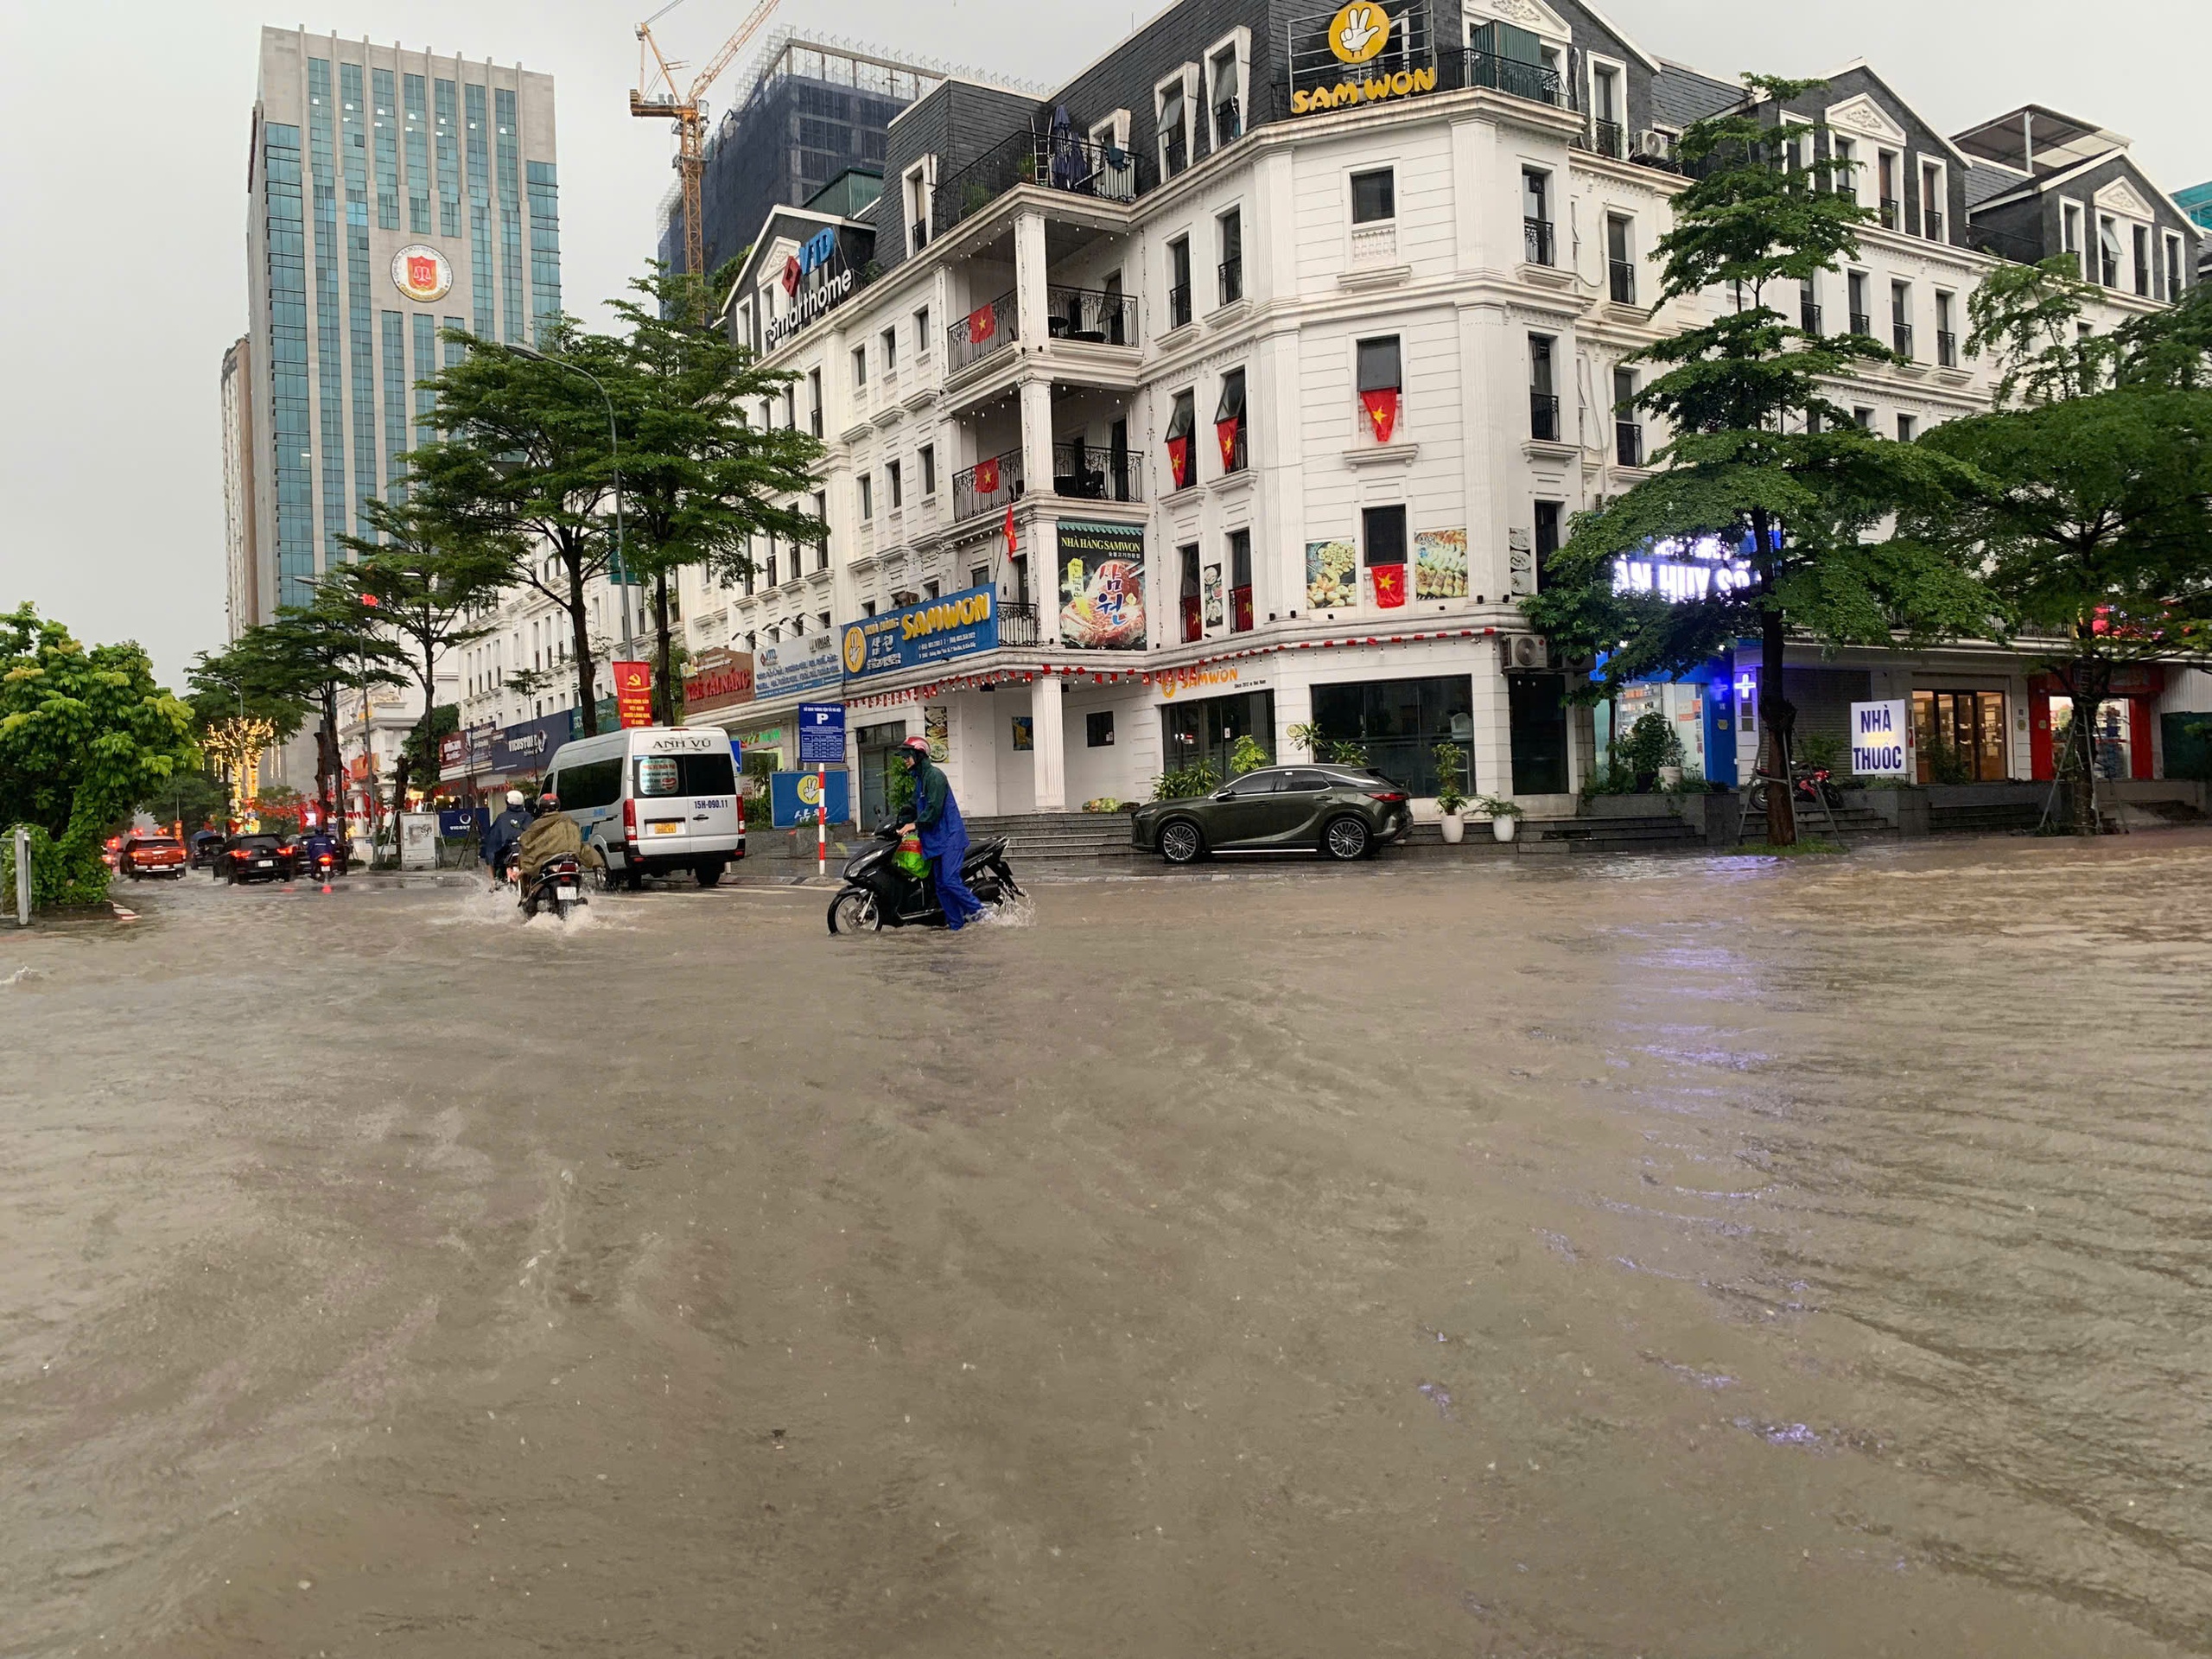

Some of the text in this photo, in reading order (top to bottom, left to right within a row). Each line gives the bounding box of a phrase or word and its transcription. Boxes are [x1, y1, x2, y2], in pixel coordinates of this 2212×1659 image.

[798, 227, 836, 276] VTD
[769, 269, 853, 341] Smarthome
[1061, 536, 1141, 552] NHÀ HÀNG SAMWON
[901, 592, 990, 640] SAMWON
[817, 713, 829, 725] P
[1860, 704, 1891, 734] NHÀ
[652, 738, 711, 748] ANH VŨ
[1853, 739, 1902, 770] THUỐC
[694, 799, 728, 810] 15H-090.11
